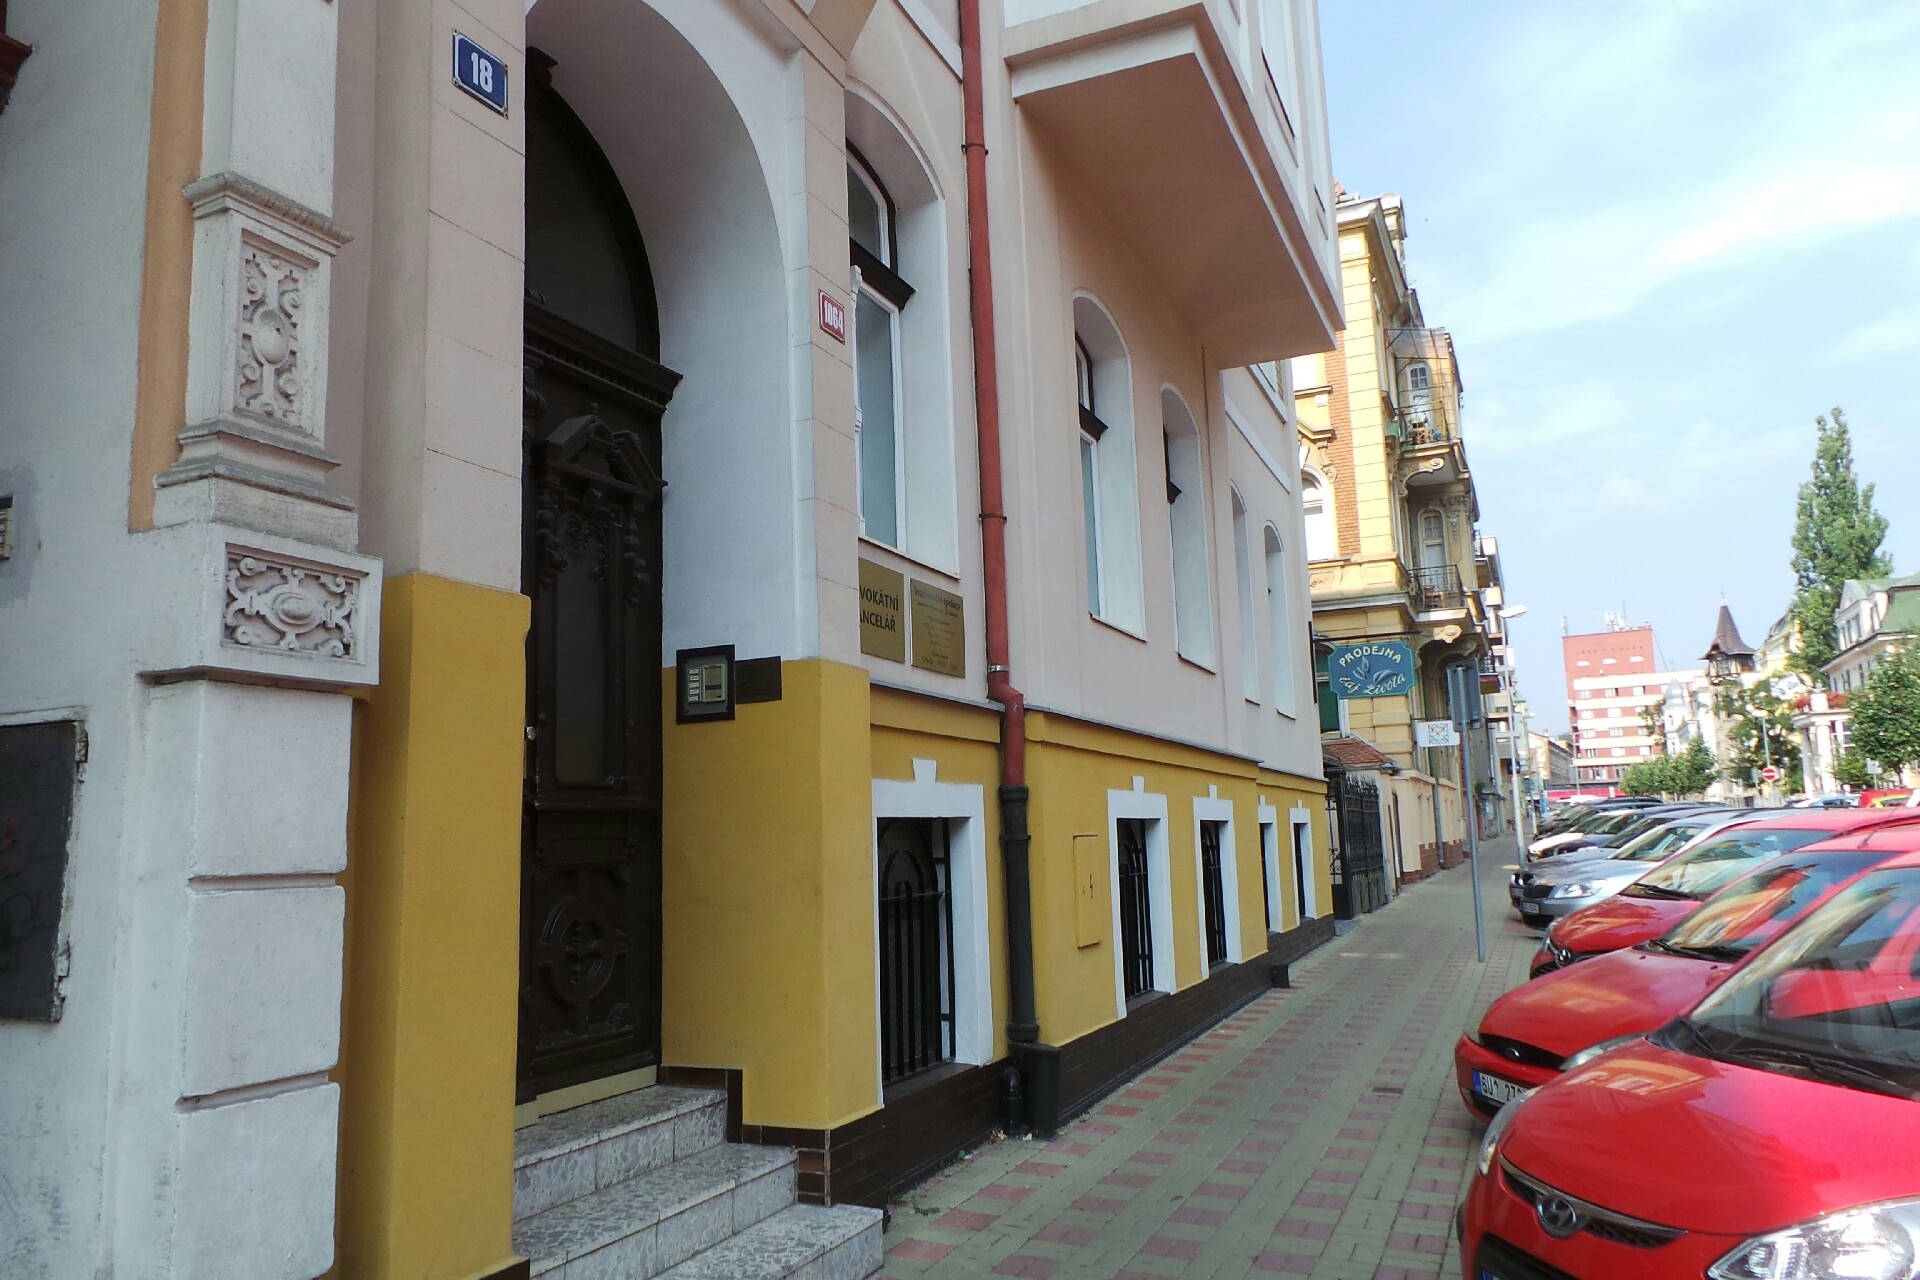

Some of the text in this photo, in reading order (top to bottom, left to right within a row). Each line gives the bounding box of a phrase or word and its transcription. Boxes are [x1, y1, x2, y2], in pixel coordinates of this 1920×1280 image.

[471, 52, 492, 93] 18
[824, 300, 843, 334] 1064
[1339, 646, 1402, 667] PRODEJNA
